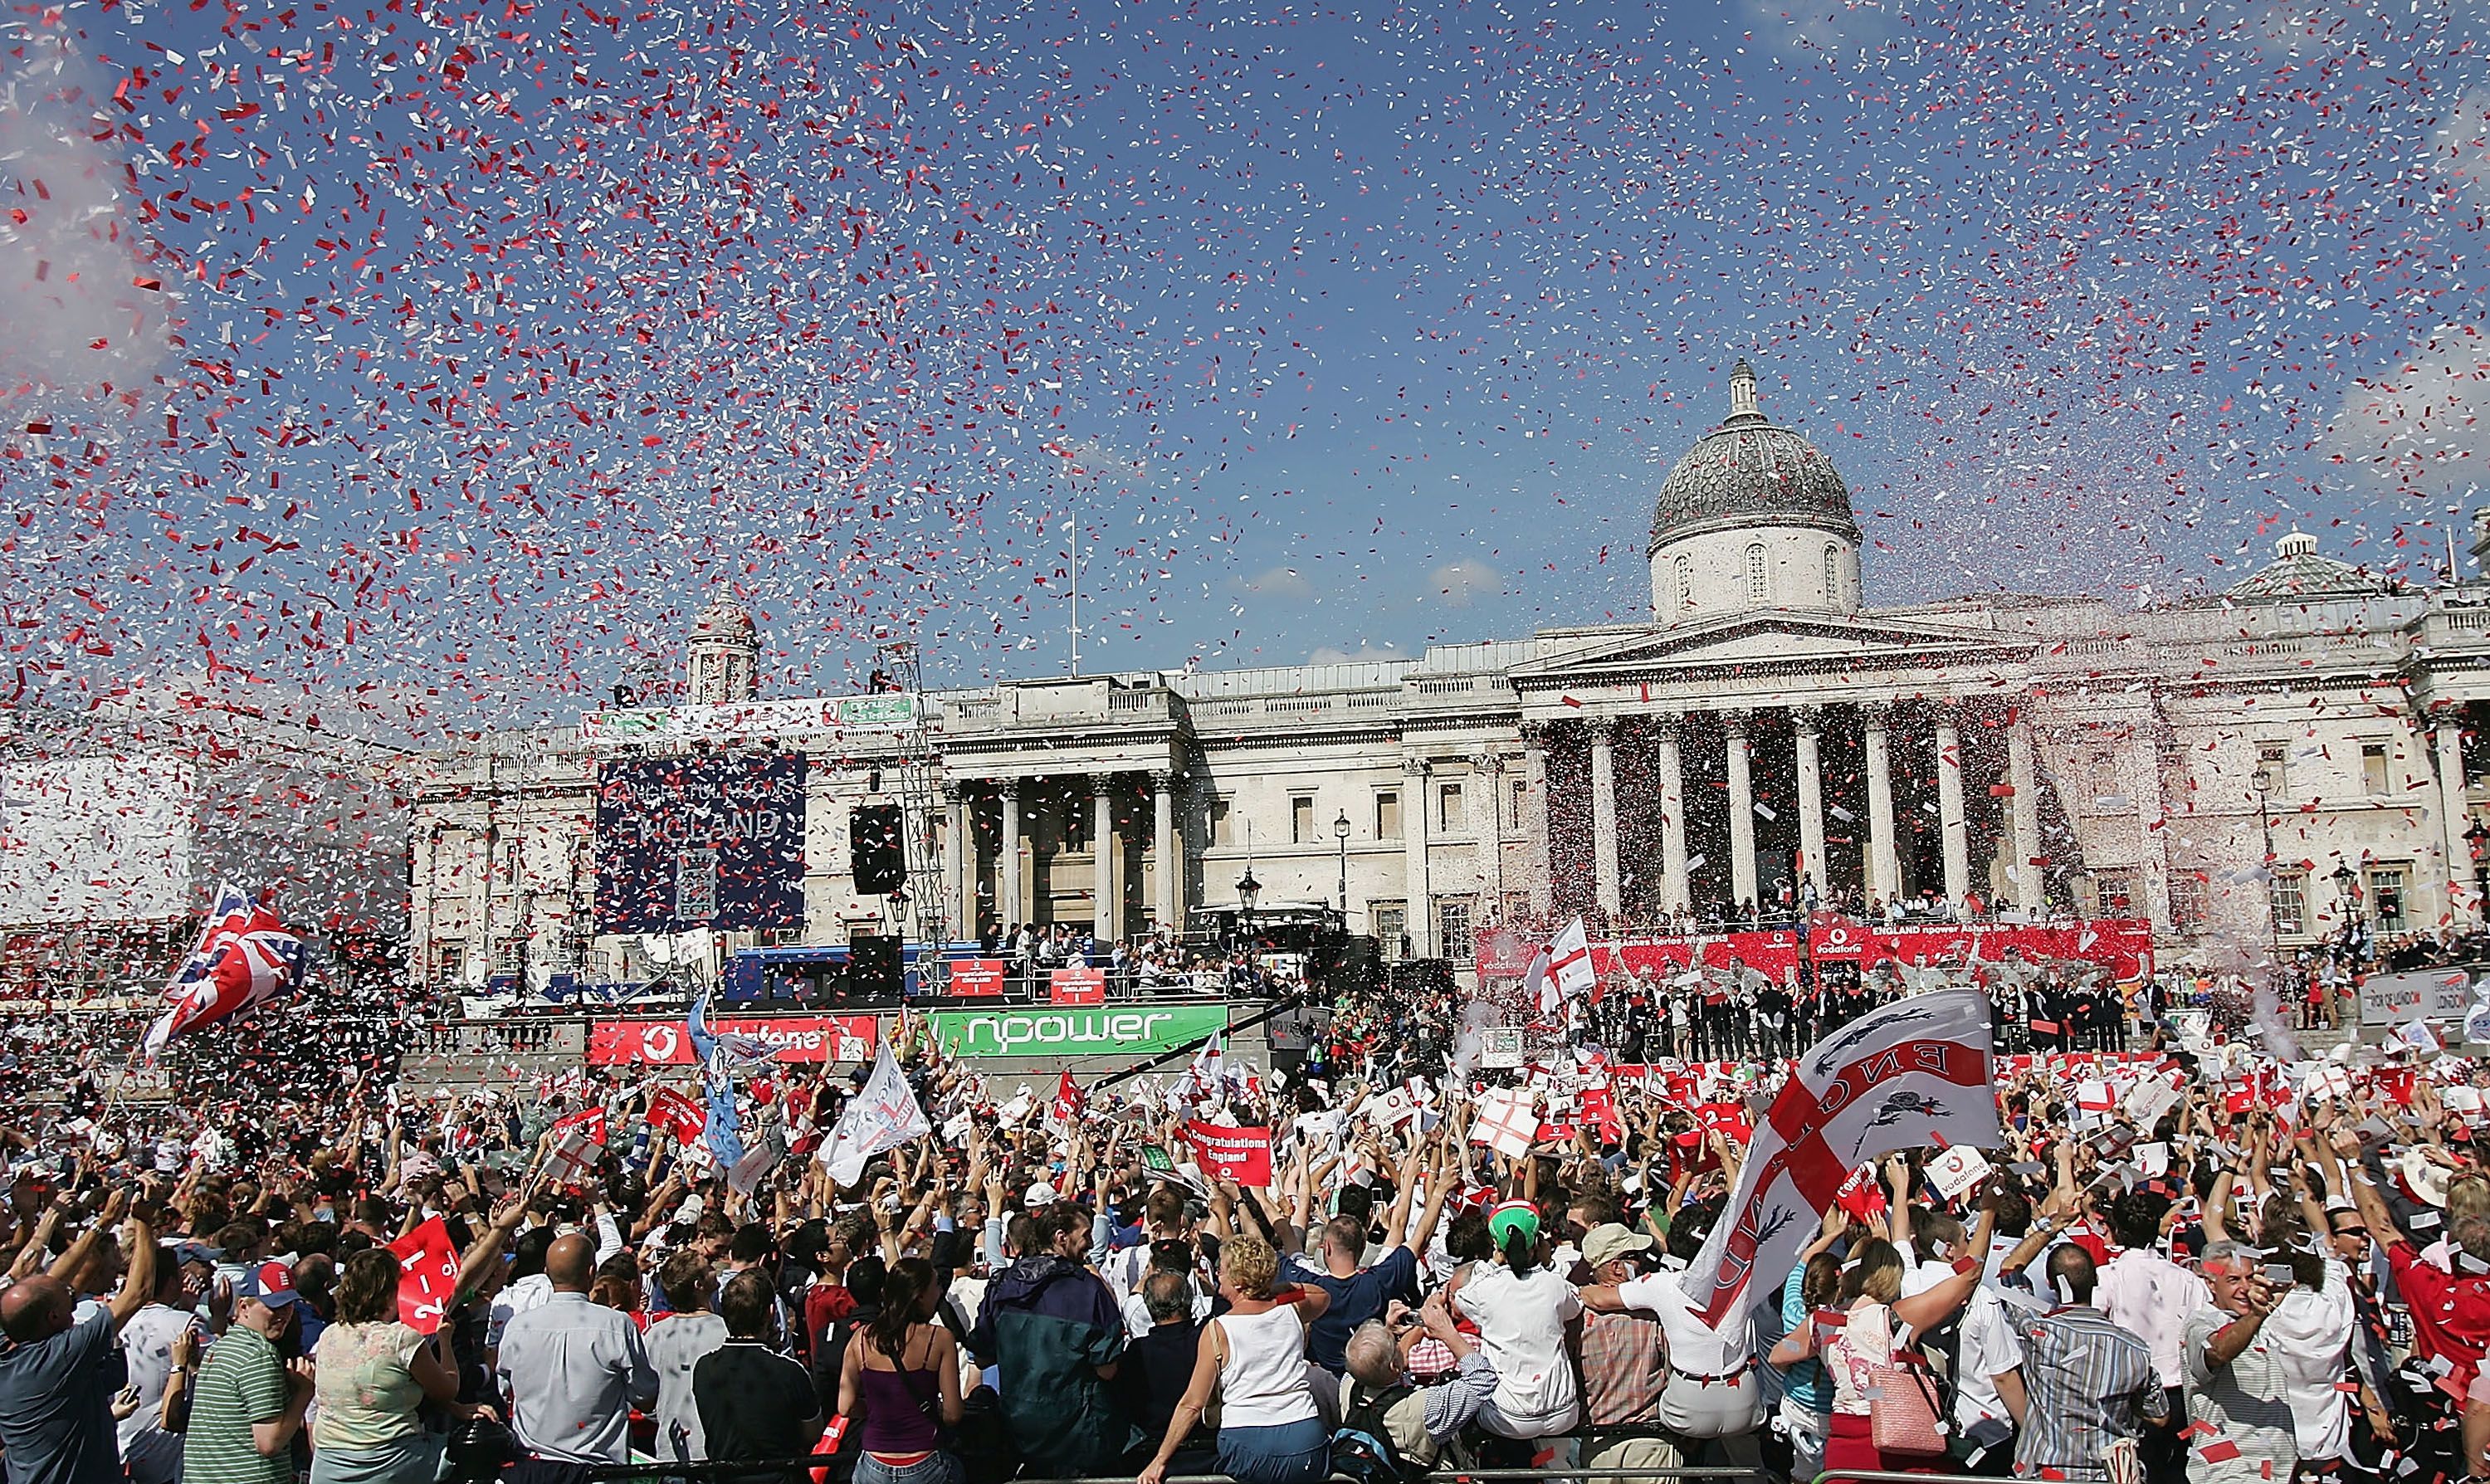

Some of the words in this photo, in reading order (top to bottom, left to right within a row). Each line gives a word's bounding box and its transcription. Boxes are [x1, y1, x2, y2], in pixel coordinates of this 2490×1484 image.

[618, 809, 781, 843] ENGLAND
[681, 905, 711, 916] ECB
[1872, 925, 1920, 935] ENGLAND
[1922, 925, 1959, 935] npower
[1684, 934, 1729, 945] WINNERS
[1816, 945, 1862, 954] vodafone
[967, 1013, 1173, 1054] npower
[1191, 1129, 1267, 1149] Congratulations
[1207, 1149, 1247, 1164] England
[1941, 1161, 1985, 1193] vodafone
